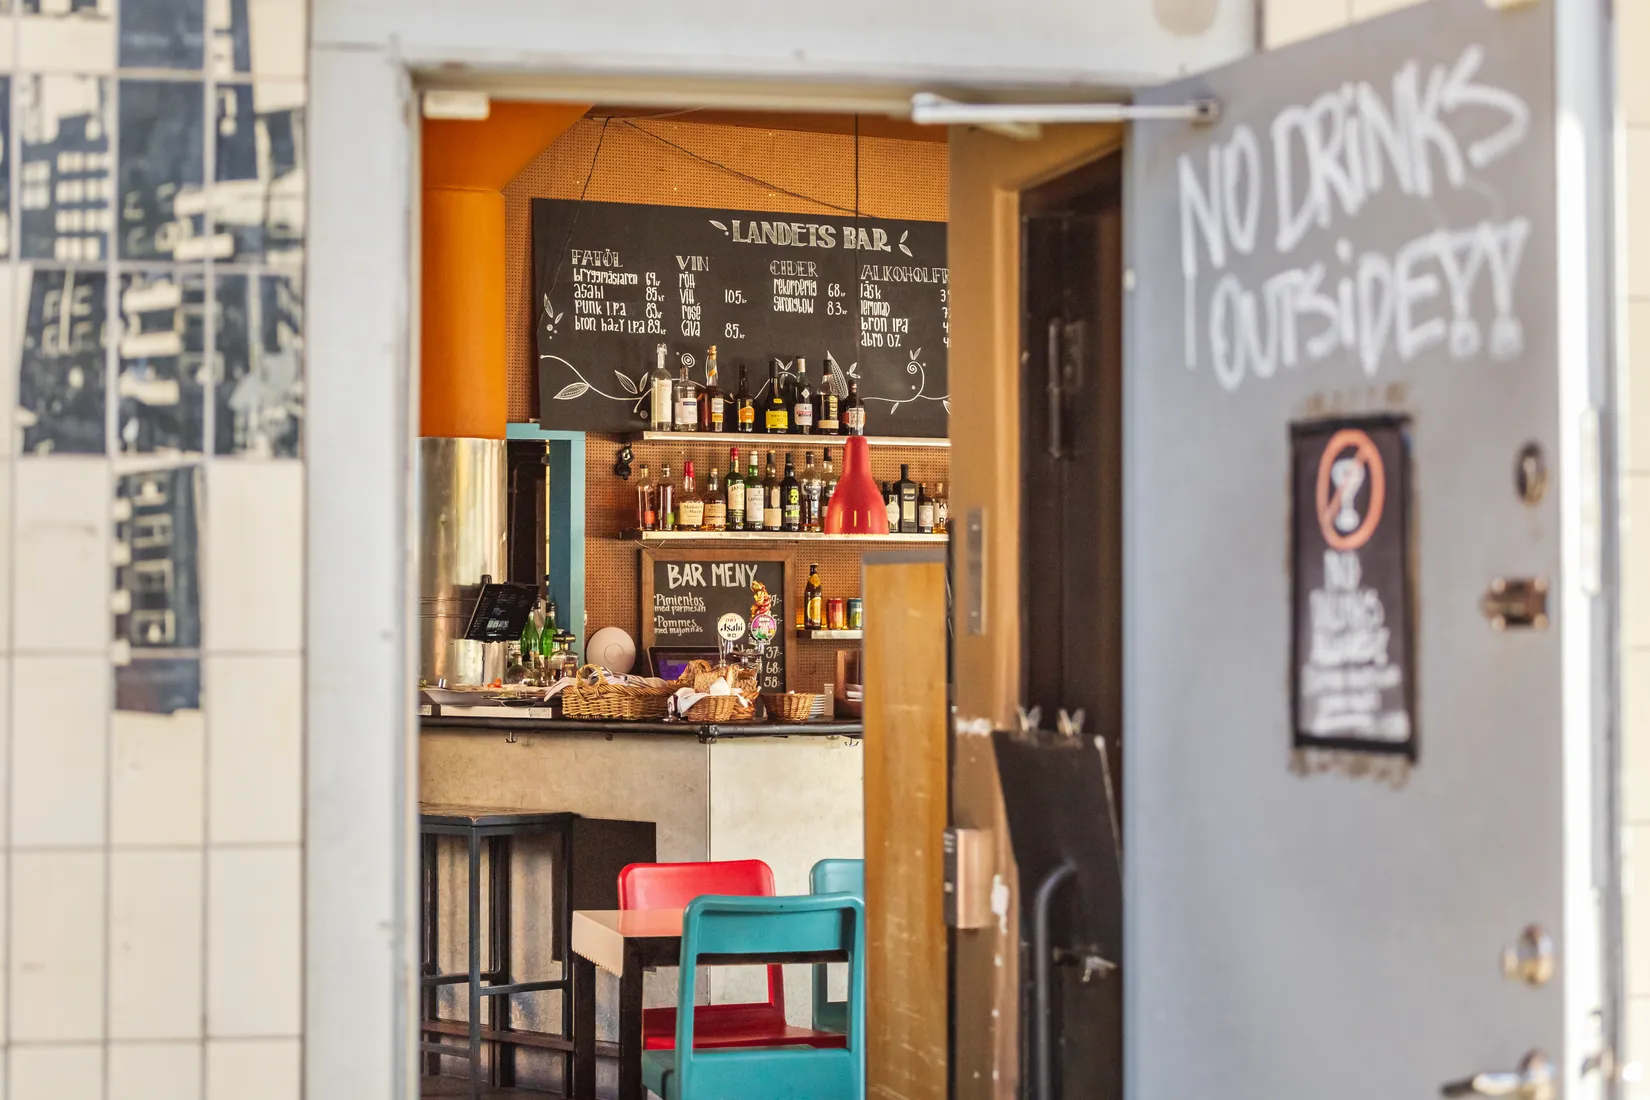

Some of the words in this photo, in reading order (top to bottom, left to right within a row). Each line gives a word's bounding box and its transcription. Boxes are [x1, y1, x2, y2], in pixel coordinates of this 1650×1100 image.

[1178, 124, 1261, 278] NO
[732, 219, 837, 249] LANDETS
[843, 226, 892, 252] BAR
[571, 248, 623, 268] FATÖL
[675, 255, 709, 272] VIN
[769, 260, 819, 277] CIDER
[667, 563, 707, 590] BAR
[711, 562, 758, 588] MENY
[656, 591, 705, 607] Pimientos
[654, 604, 670, 612] med
[654, 625, 668, 634] med
[657, 615, 698, 628] Pommes
[720, 622, 743, 632] Asahi
